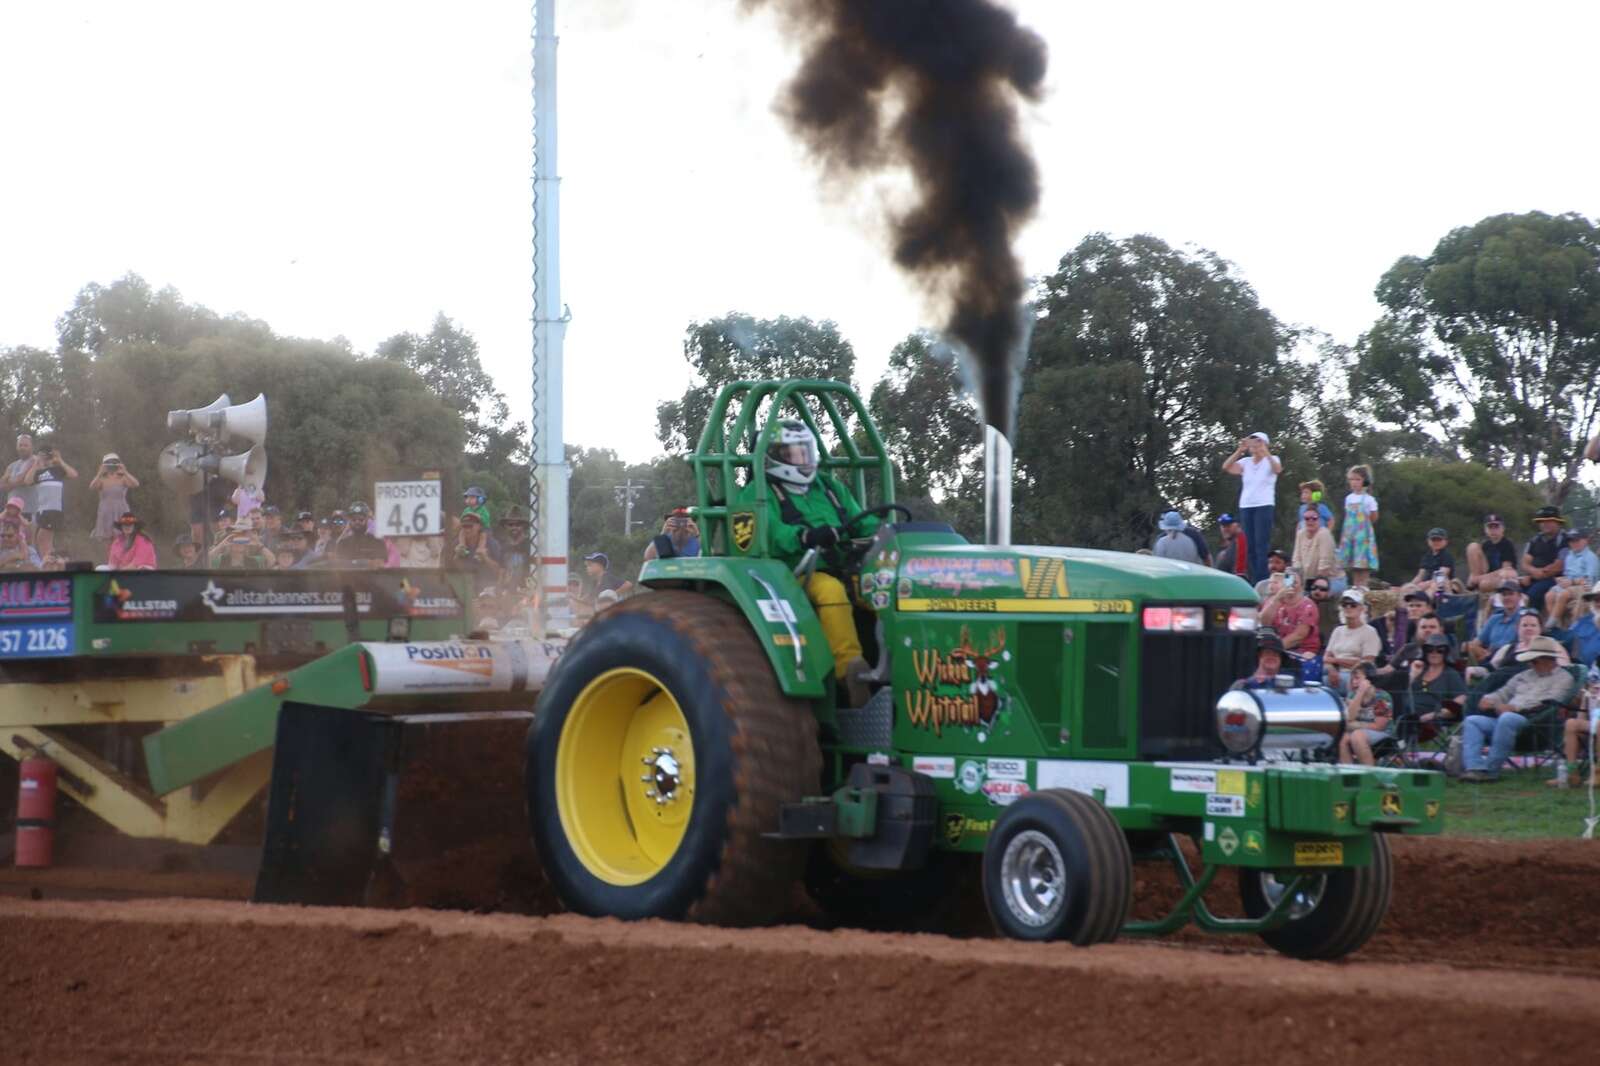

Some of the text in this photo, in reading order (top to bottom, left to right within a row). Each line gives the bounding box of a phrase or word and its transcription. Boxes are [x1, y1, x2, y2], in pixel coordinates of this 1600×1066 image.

[377, 484, 440, 499] PROSTOCK
[386, 503, 429, 534] 4.6
[123, 599, 177, 610] ALLSTAR
[959, 600, 996, 611] DEERE
[27, 628, 68, 651] 2126
